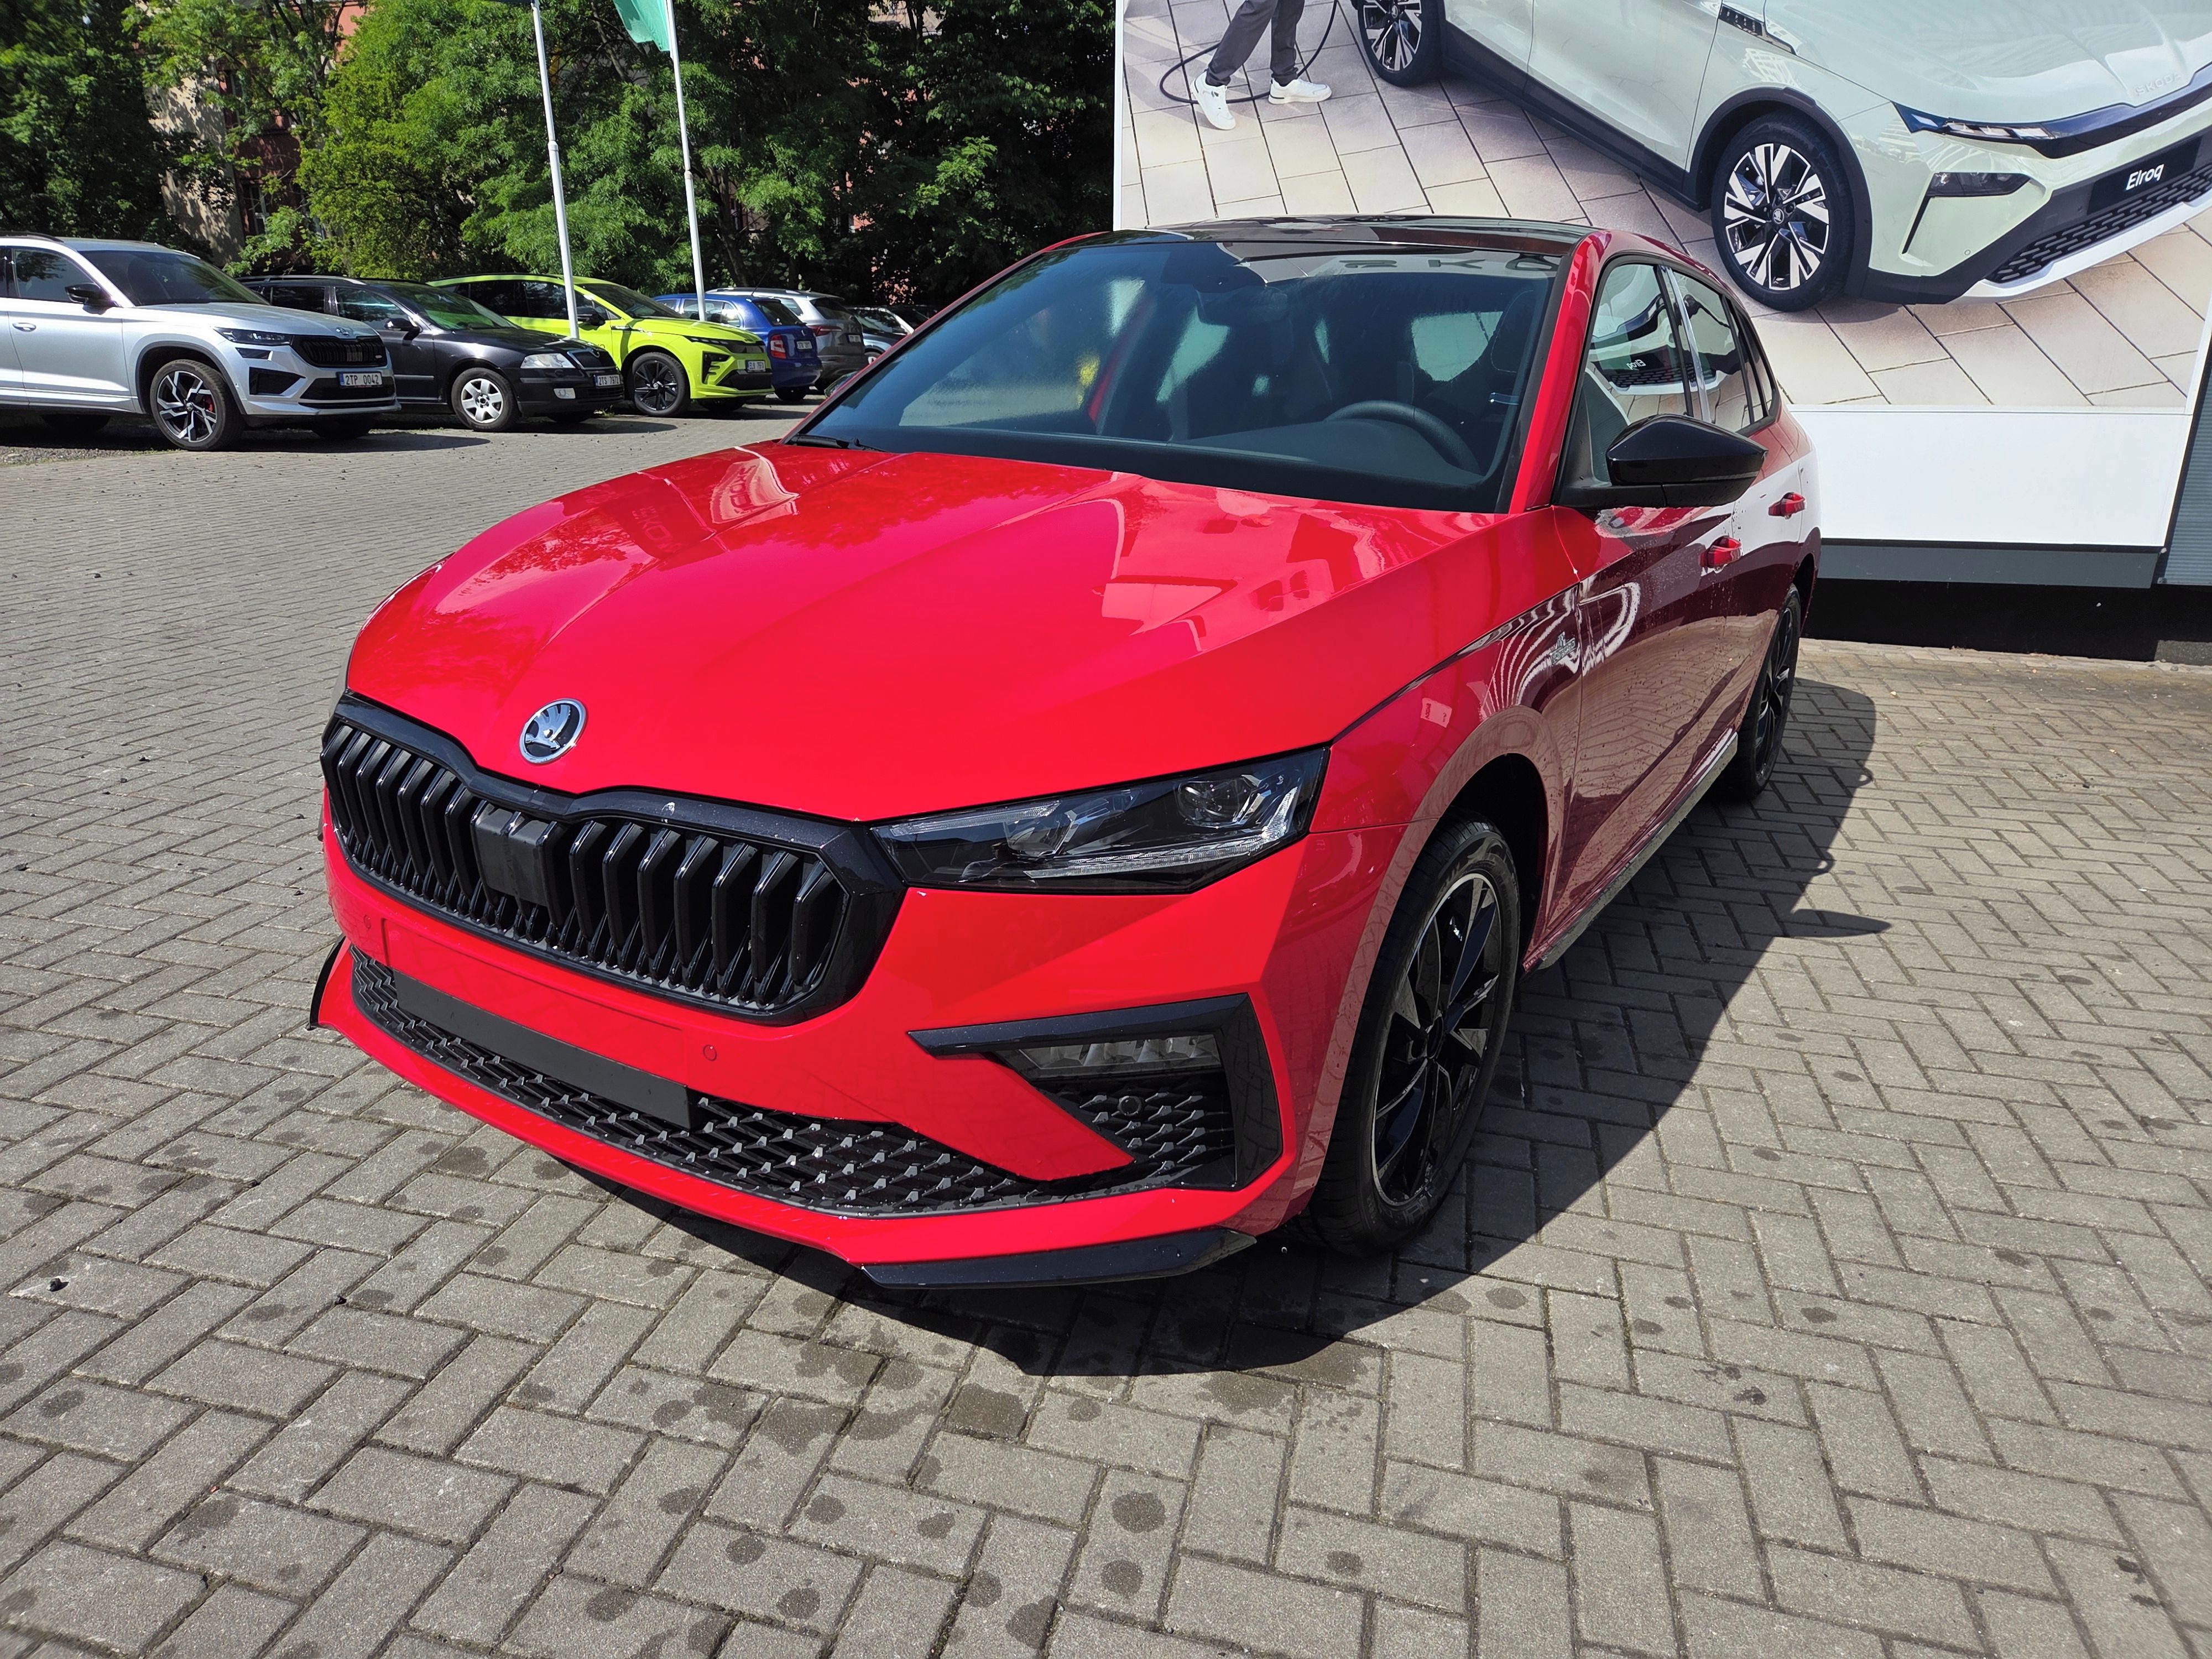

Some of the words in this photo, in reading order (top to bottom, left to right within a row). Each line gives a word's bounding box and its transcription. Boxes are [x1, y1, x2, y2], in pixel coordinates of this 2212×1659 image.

[2126, 164, 2164, 190] Elroq
[345, 375, 358, 385] 2TP
[363, 374, 379, 384] 0042
[598, 376, 607, 385] 2TS
